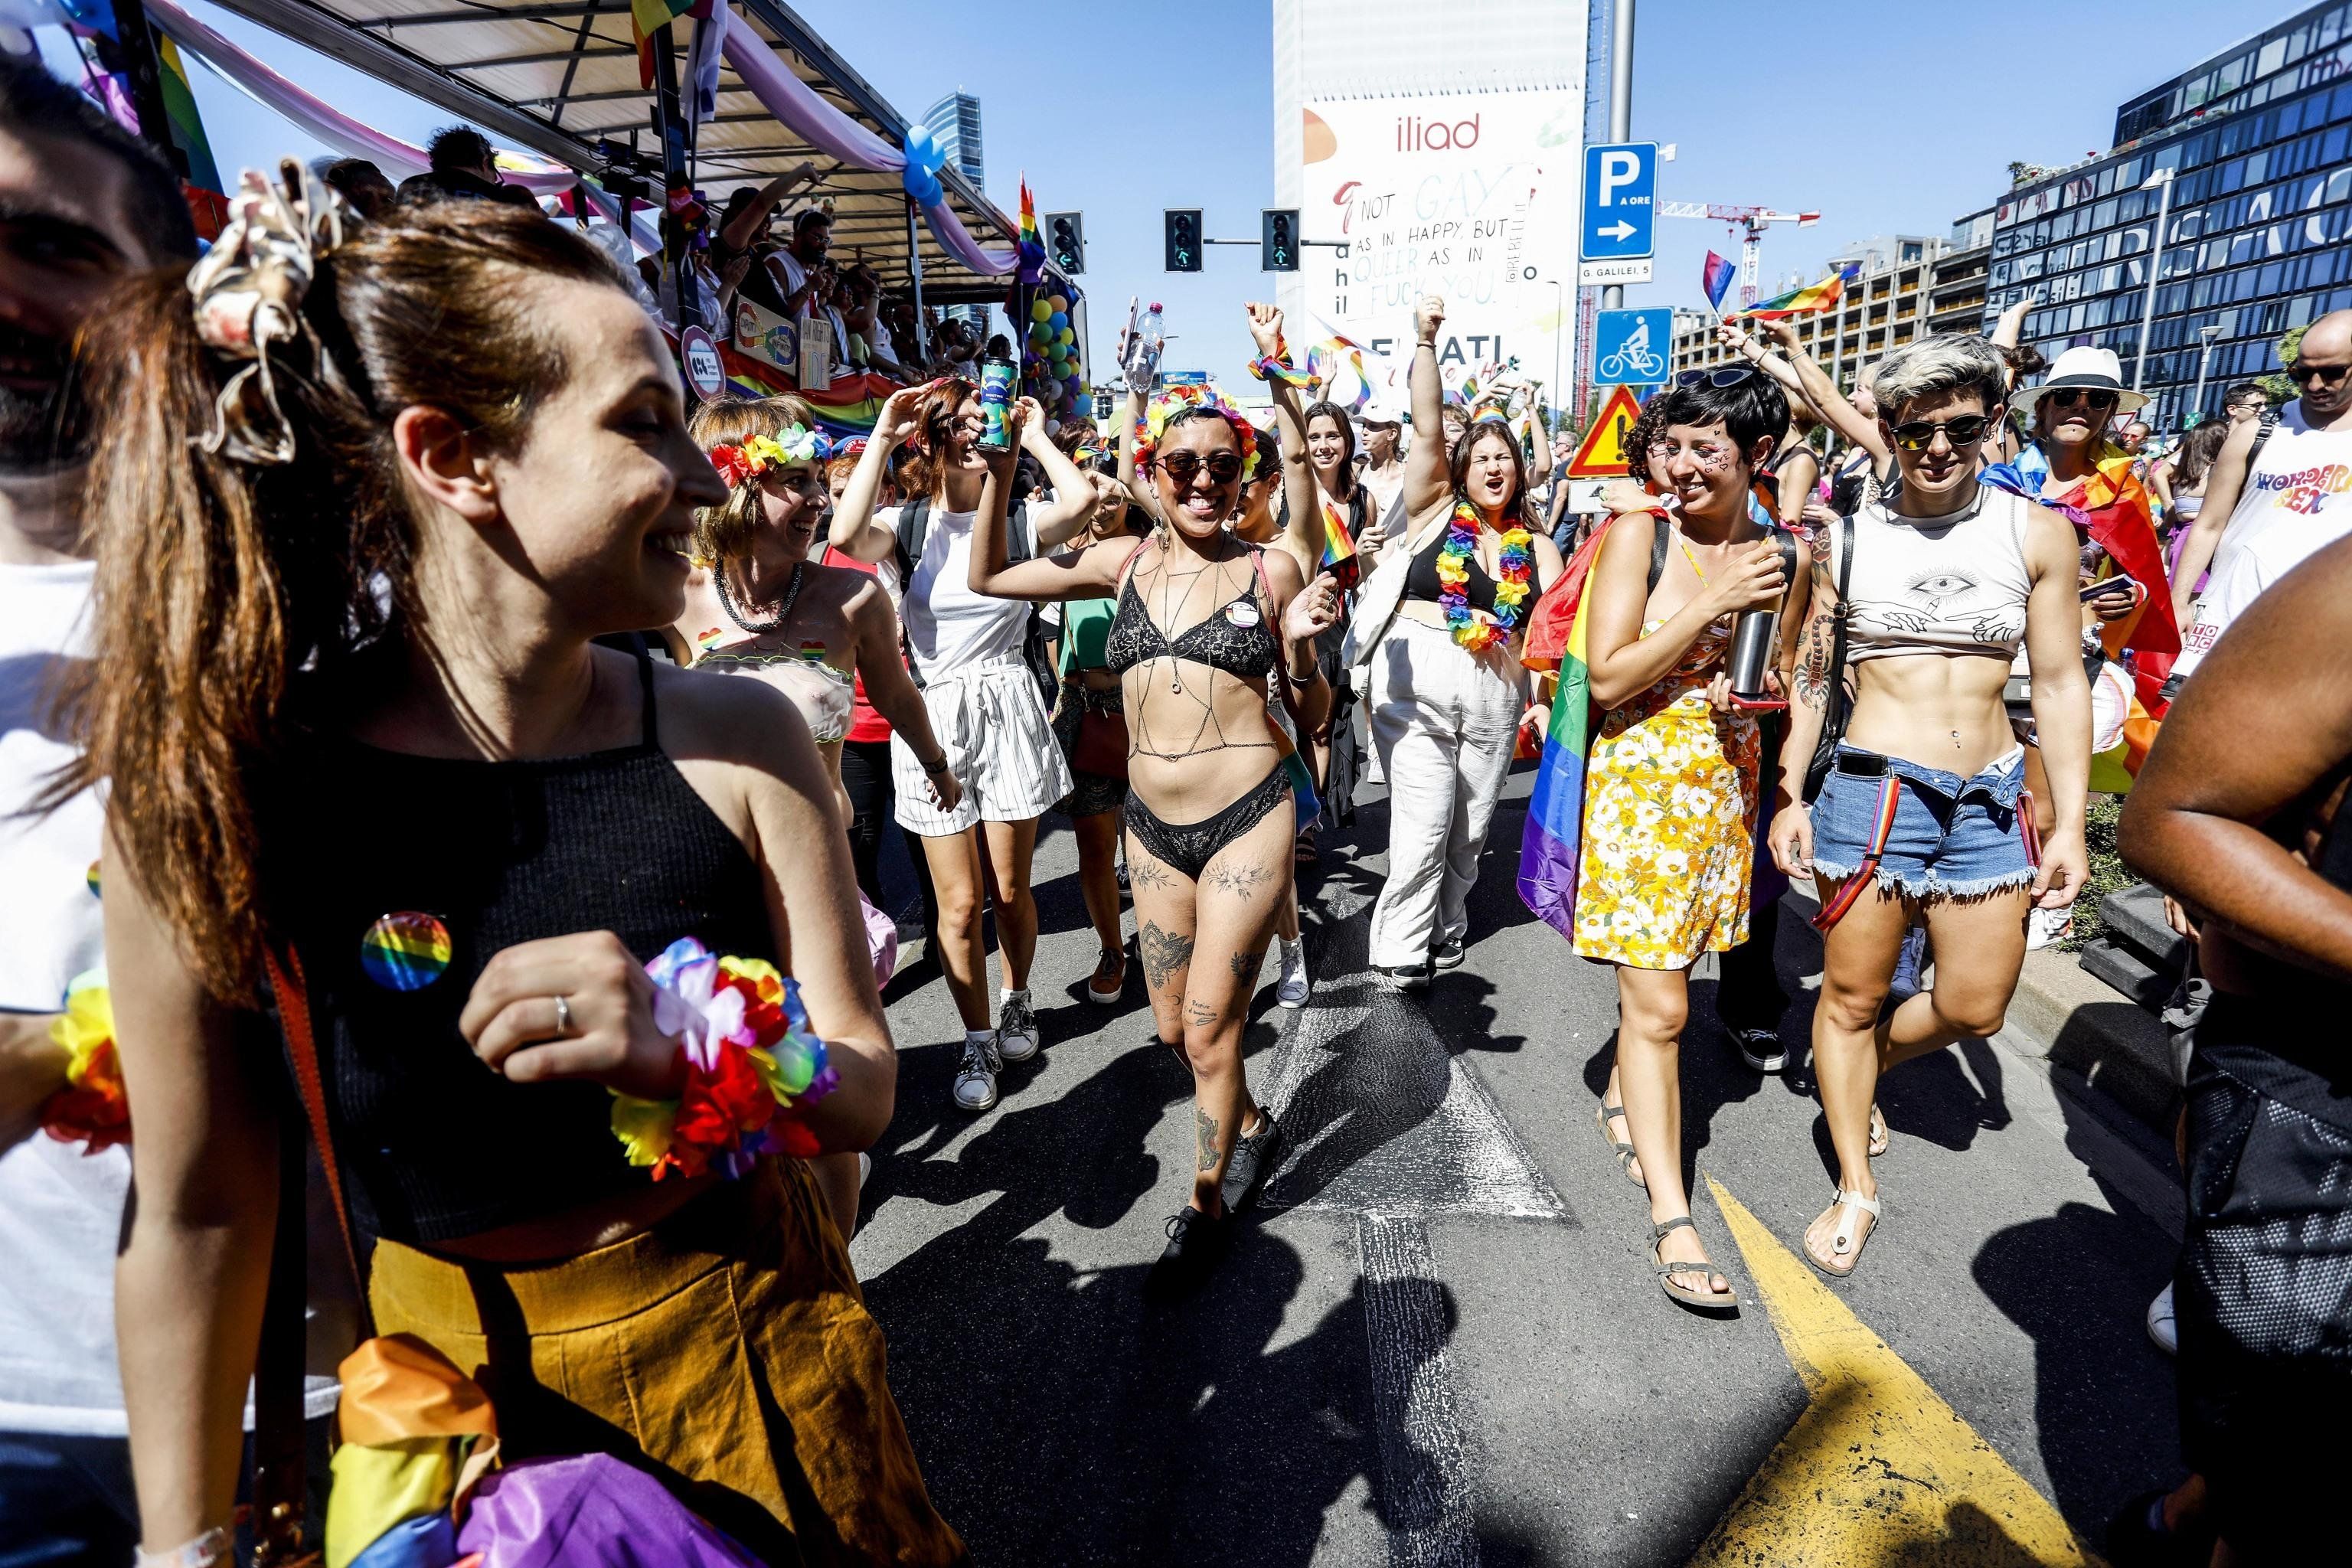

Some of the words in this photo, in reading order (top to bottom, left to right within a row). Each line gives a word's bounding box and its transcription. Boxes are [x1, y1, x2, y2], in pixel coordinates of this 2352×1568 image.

[1396, 113, 1479, 152] iliad
[1361, 193, 1396, 222] NOT
[1415, 165, 1513, 220] GAY
[1599, 150, 1641, 207] P
[1620, 197, 1628, 205] A
[1629, 196, 1651, 205] ORE
[1356, 237, 1372, 253] AS
[1382, 231, 1395, 246] IN
[1473, 218, 1509, 239] BUT
[1354, 248, 1418, 283] QUEER
[1427, 248, 1451, 266] AS
[1468, 247, 1483, 263] IN
[1583, 269, 1593, 278] G.
[1643, 266, 1649, 274] 5
[1371, 276, 1426, 315] FUCK
[1704, 453, 1730, 466] LOVE
[2274, 487, 2330, 514] SEX
